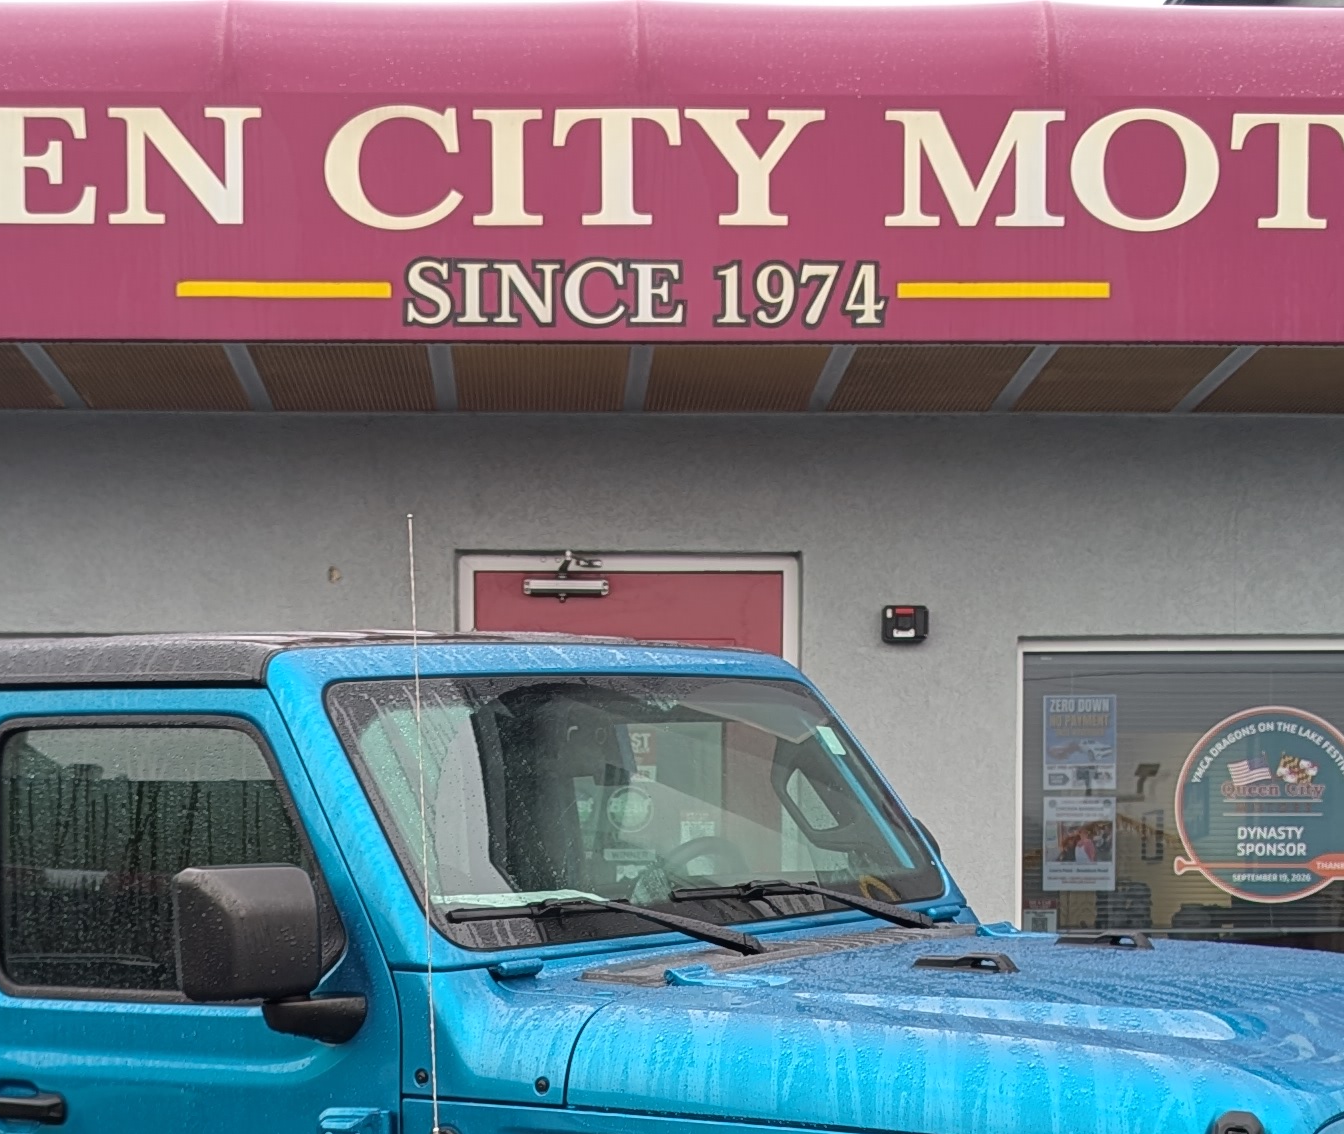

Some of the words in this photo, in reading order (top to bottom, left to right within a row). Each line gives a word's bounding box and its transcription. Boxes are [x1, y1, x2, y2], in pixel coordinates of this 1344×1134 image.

[324, 105, 825, 231] CITY
[405, 258, 684, 327] SINCE
[713, 259, 886, 329] 1974
[1050, 699, 1075, 712] ZERO
[1078, 699, 1110, 712] DOWN
[1191, 755, 1213, 782] YMCA
[1209, 724, 1257, 757] DRAGONS
[1257, 721, 1275, 733] ON
[1276, 721, 1298, 734] THE
[1298, 726, 1324, 746] LAKE
[1220, 781, 1281, 799] Queen
[1285, 782, 1326, 800] City
[1237, 826, 1304, 840] DYNASTY
[1236, 842, 1307, 857] SPONSOR
[1232, 873, 1277, 882] SEPTEMBER
